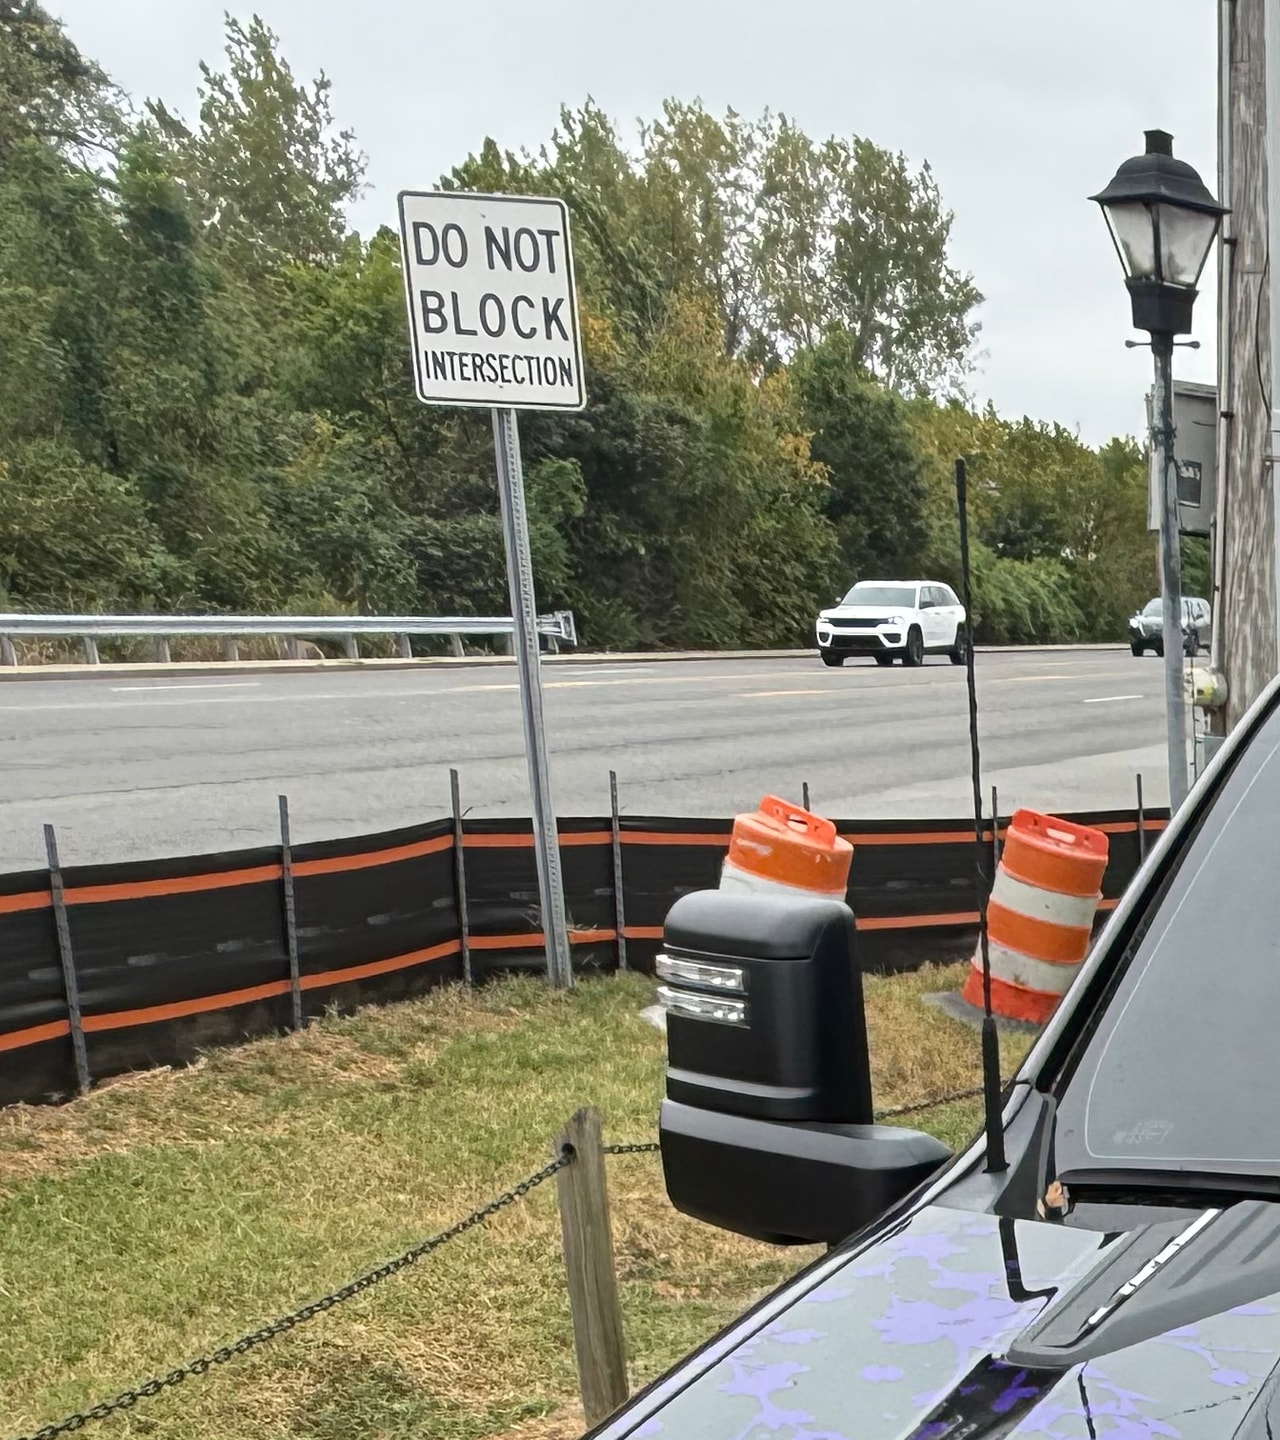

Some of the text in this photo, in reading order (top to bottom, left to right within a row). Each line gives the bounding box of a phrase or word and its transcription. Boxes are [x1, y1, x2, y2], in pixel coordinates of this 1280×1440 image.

[412, 221, 560, 274] DO NOT
[420, 289, 569, 342] BLOCK
[424, 350, 573, 387] INTERSECTION
